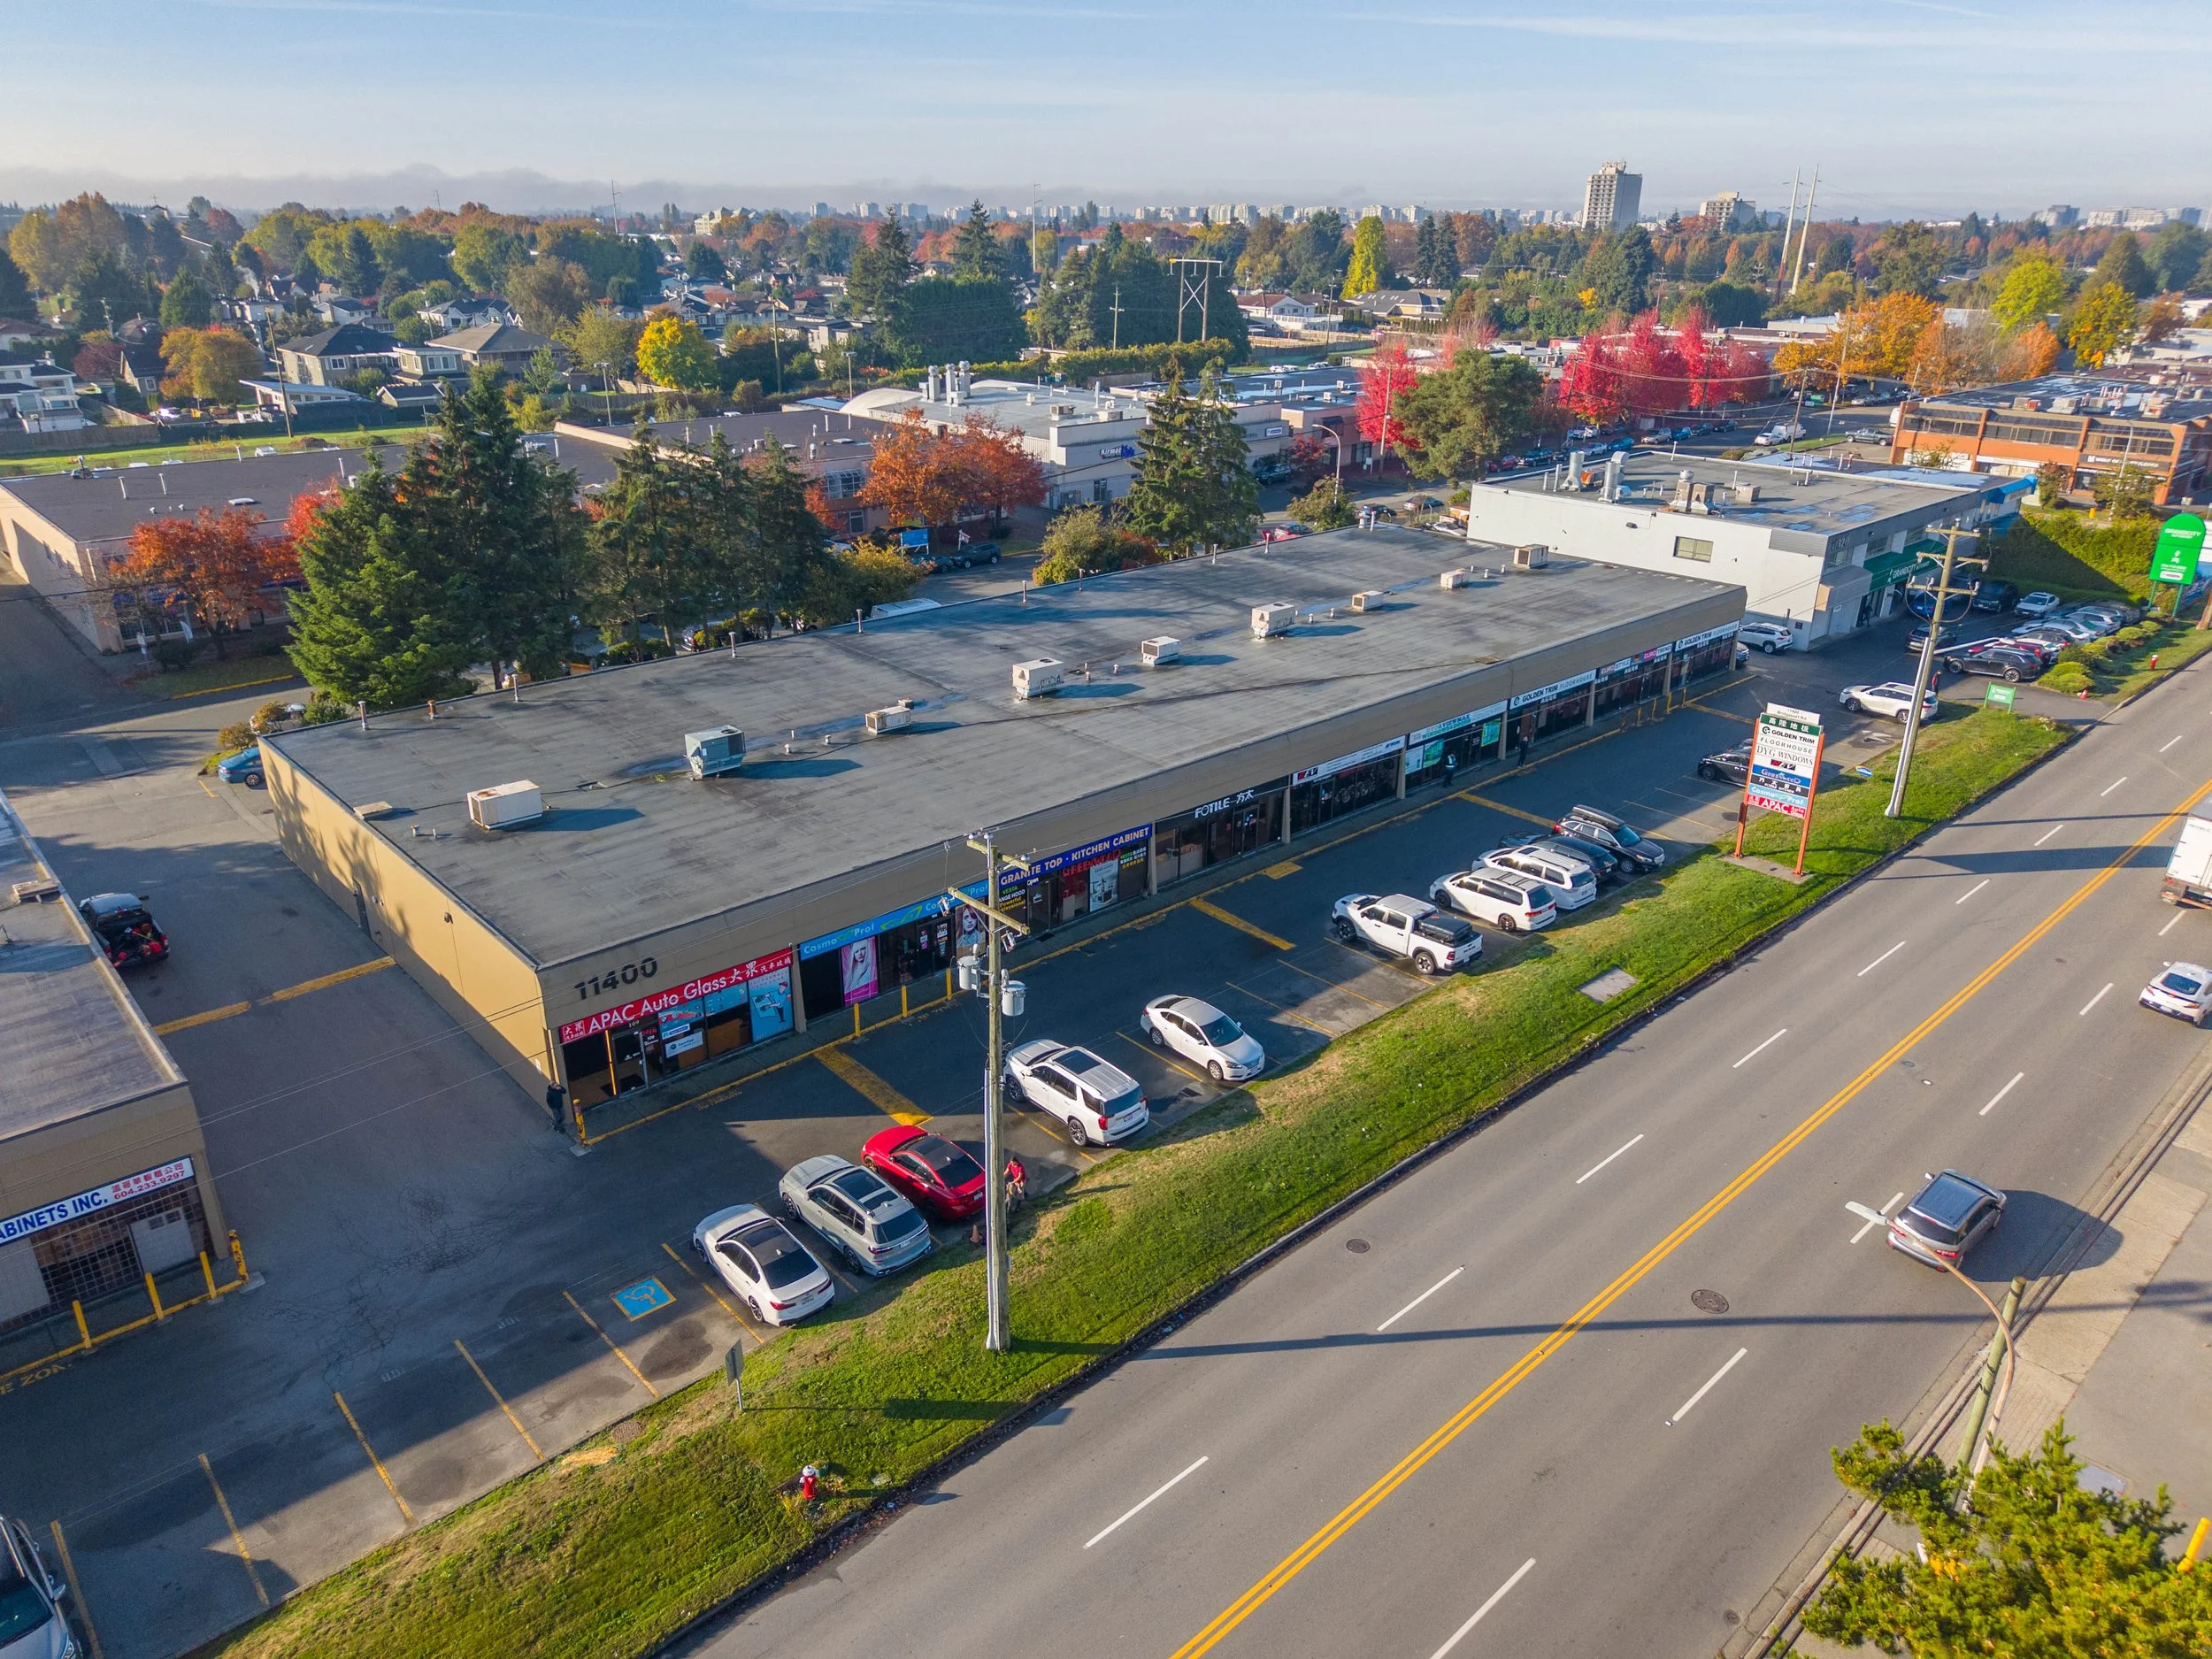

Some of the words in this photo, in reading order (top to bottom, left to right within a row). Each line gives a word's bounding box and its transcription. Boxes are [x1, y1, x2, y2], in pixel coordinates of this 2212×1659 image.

[1522, 690, 1544, 702] GOLDEN
[1545, 684, 1558, 694] TRIM
[1760, 737, 1813, 754] FLOORHOUSE
[1771, 729, 1797, 741] GOLDEN
[1799, 735, 1815, 744] TRIM
[1756, 745, 1776, 757] DYG
[1778, 751, 1813, 765] WINDOWS
[1751, 787, 1775, 797] Cosmo
[1787, 795, 1804, 805] Prof
[1761, 799, 1790, 813] APAC
[1194, 797, 1230, 818] FOTILE
[1001, 865, 1041, 886] GRANITE
[1045, 857, 1063, 871] TOP
[1071, 841, 1110, 861] KITCHEN
[1113, 827, 1149, 847] CABINET
[804, 938, 837, 954] Cosmo
[854, 923, 875, 937] Prof
[574, 957, 658, 1000] 11400
[588, 1004, 634, 1034] APAC
[641, 990, 679, 1016] Auto
[684, 977, 726, 1000] Glass
[113, 1171, 185, 1200] 604.233.9297
[74, 1191, 108, 1214] INC.
